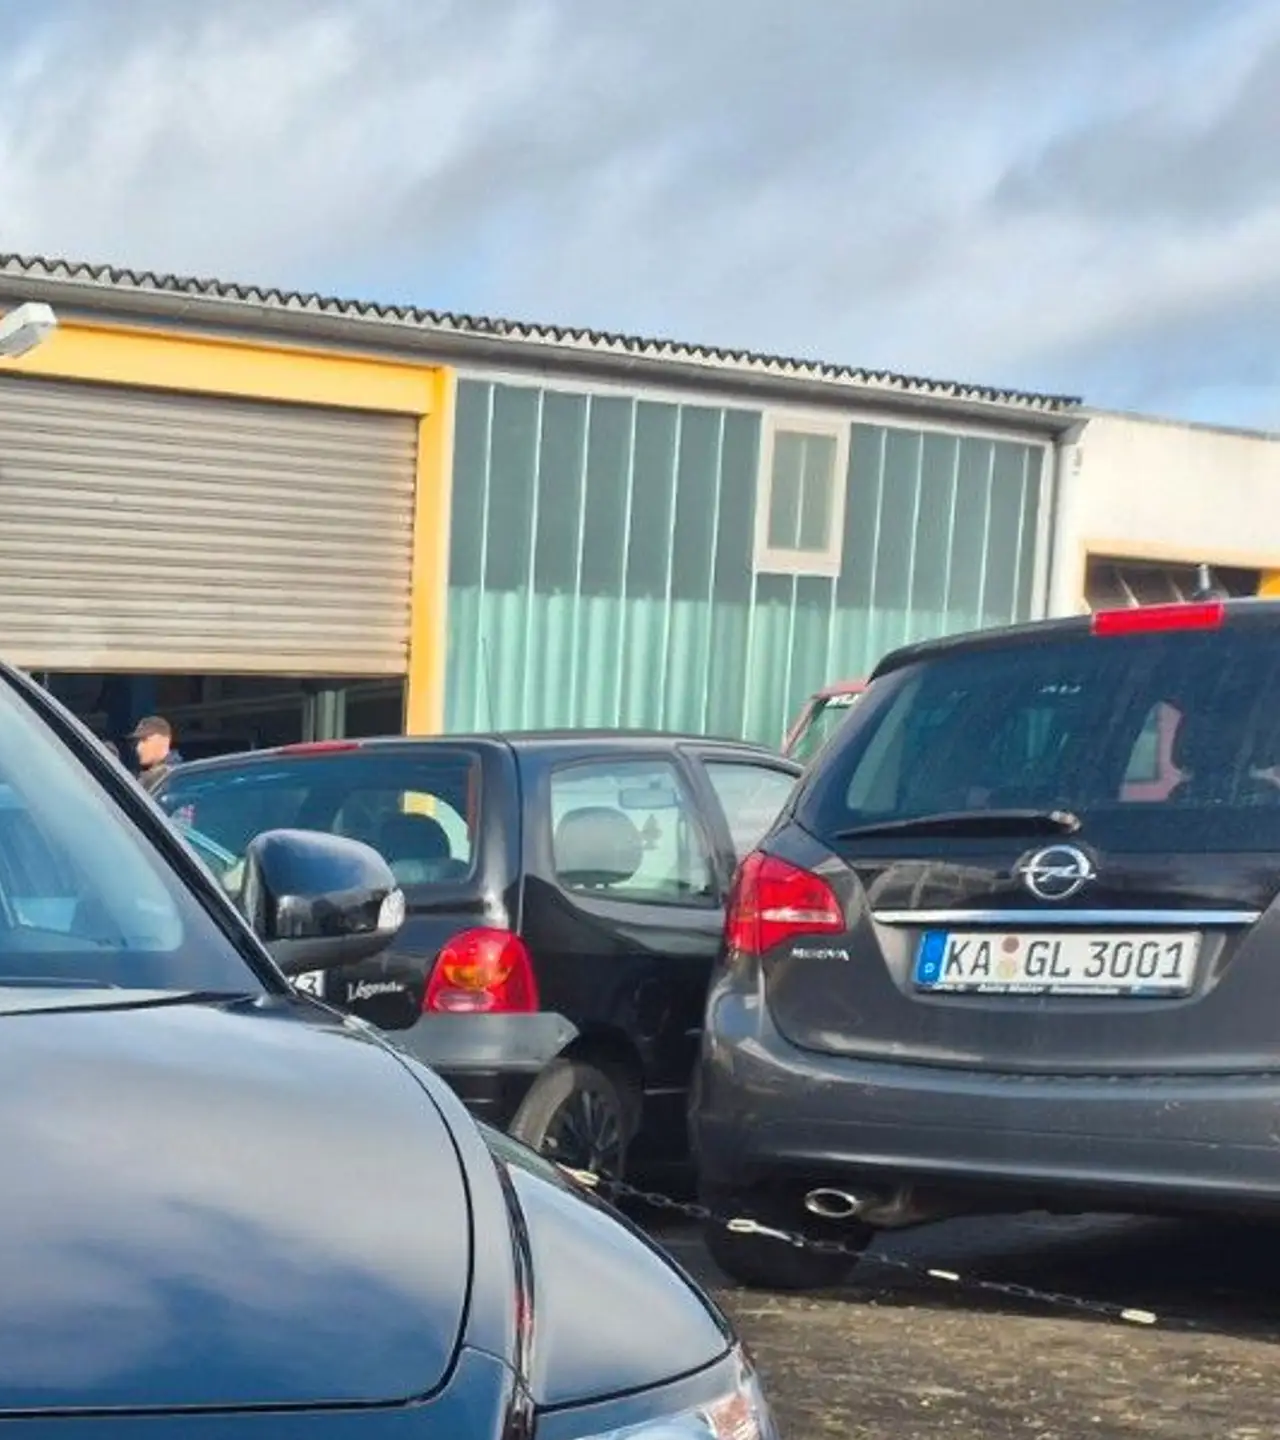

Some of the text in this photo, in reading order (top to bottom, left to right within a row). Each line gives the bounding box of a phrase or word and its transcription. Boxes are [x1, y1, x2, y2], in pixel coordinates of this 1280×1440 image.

[945, 940, 1183, 978] KA GL 3001
